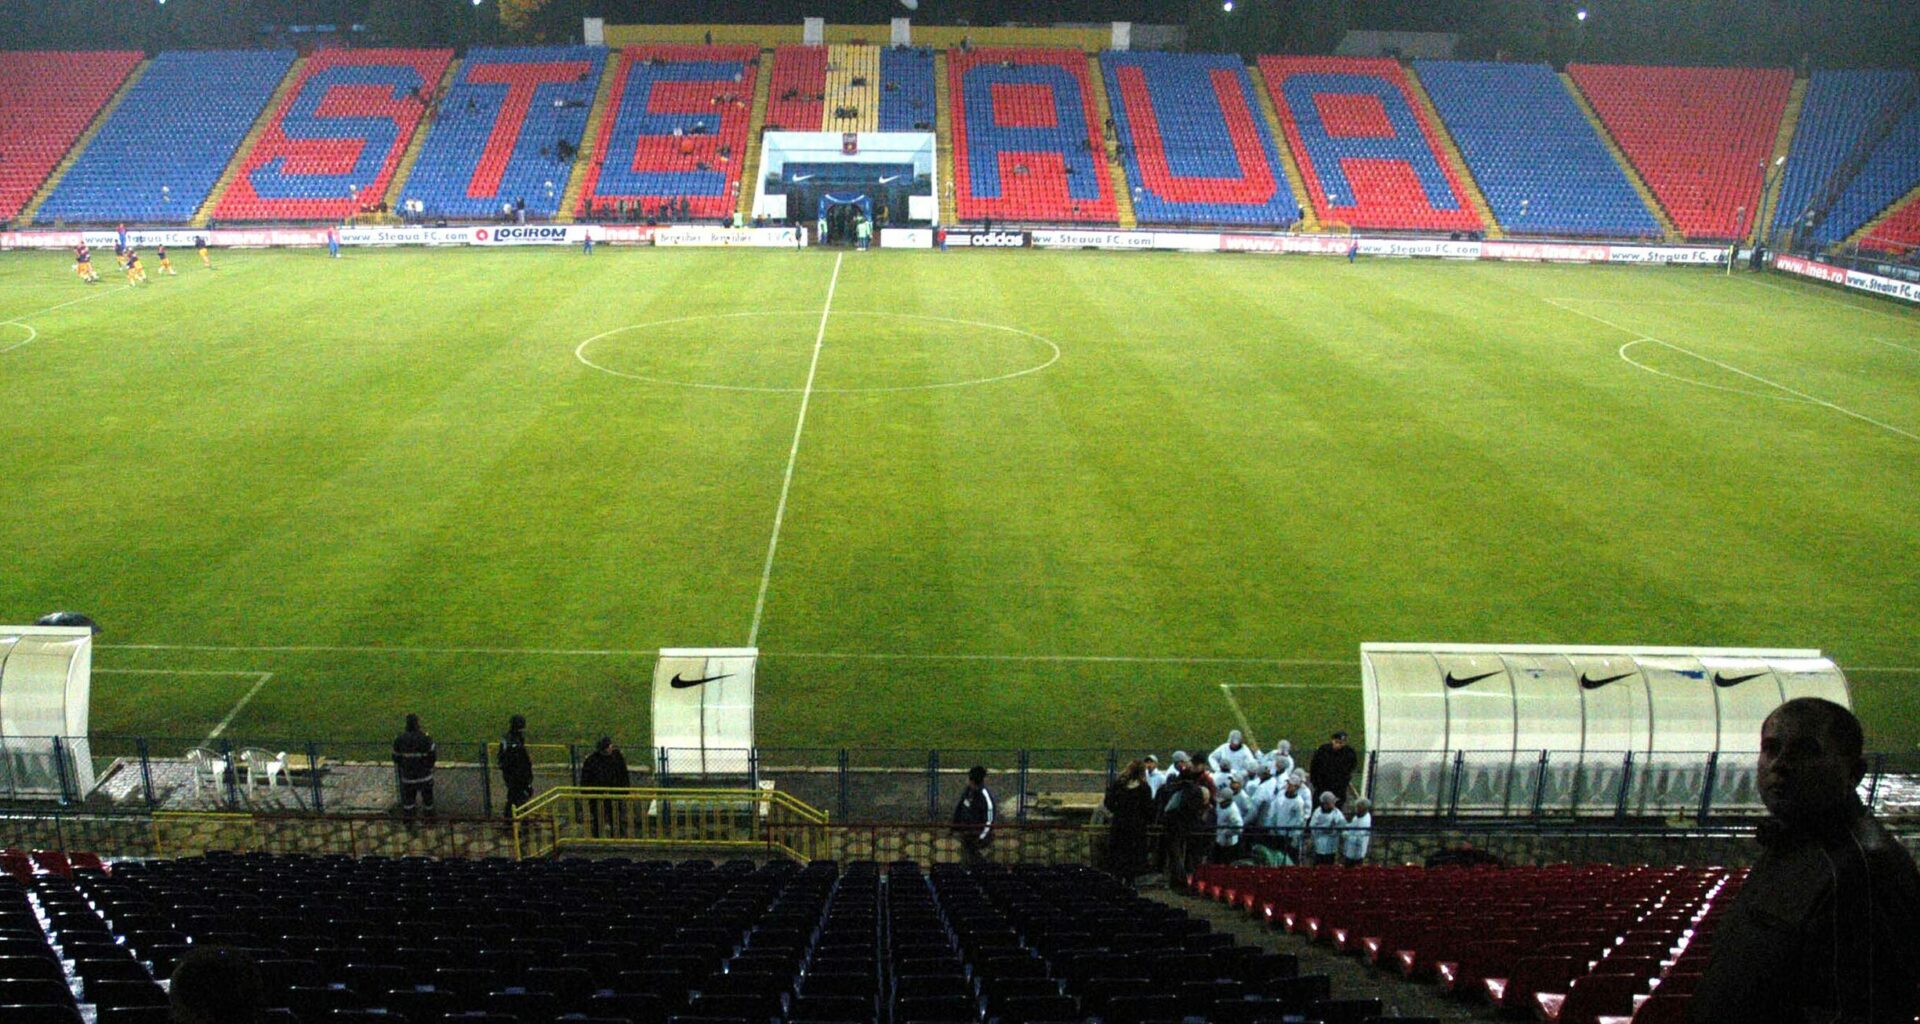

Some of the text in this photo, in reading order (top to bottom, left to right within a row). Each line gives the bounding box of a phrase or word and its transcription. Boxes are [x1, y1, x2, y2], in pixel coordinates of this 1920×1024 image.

[248, 60, 1460, 211] STEAUA
[494, 228, 567, 241] LOGIROM
[972, 232, 1023, 246] adidas
[1776, 258, 1843, 283] www.ines.ro
